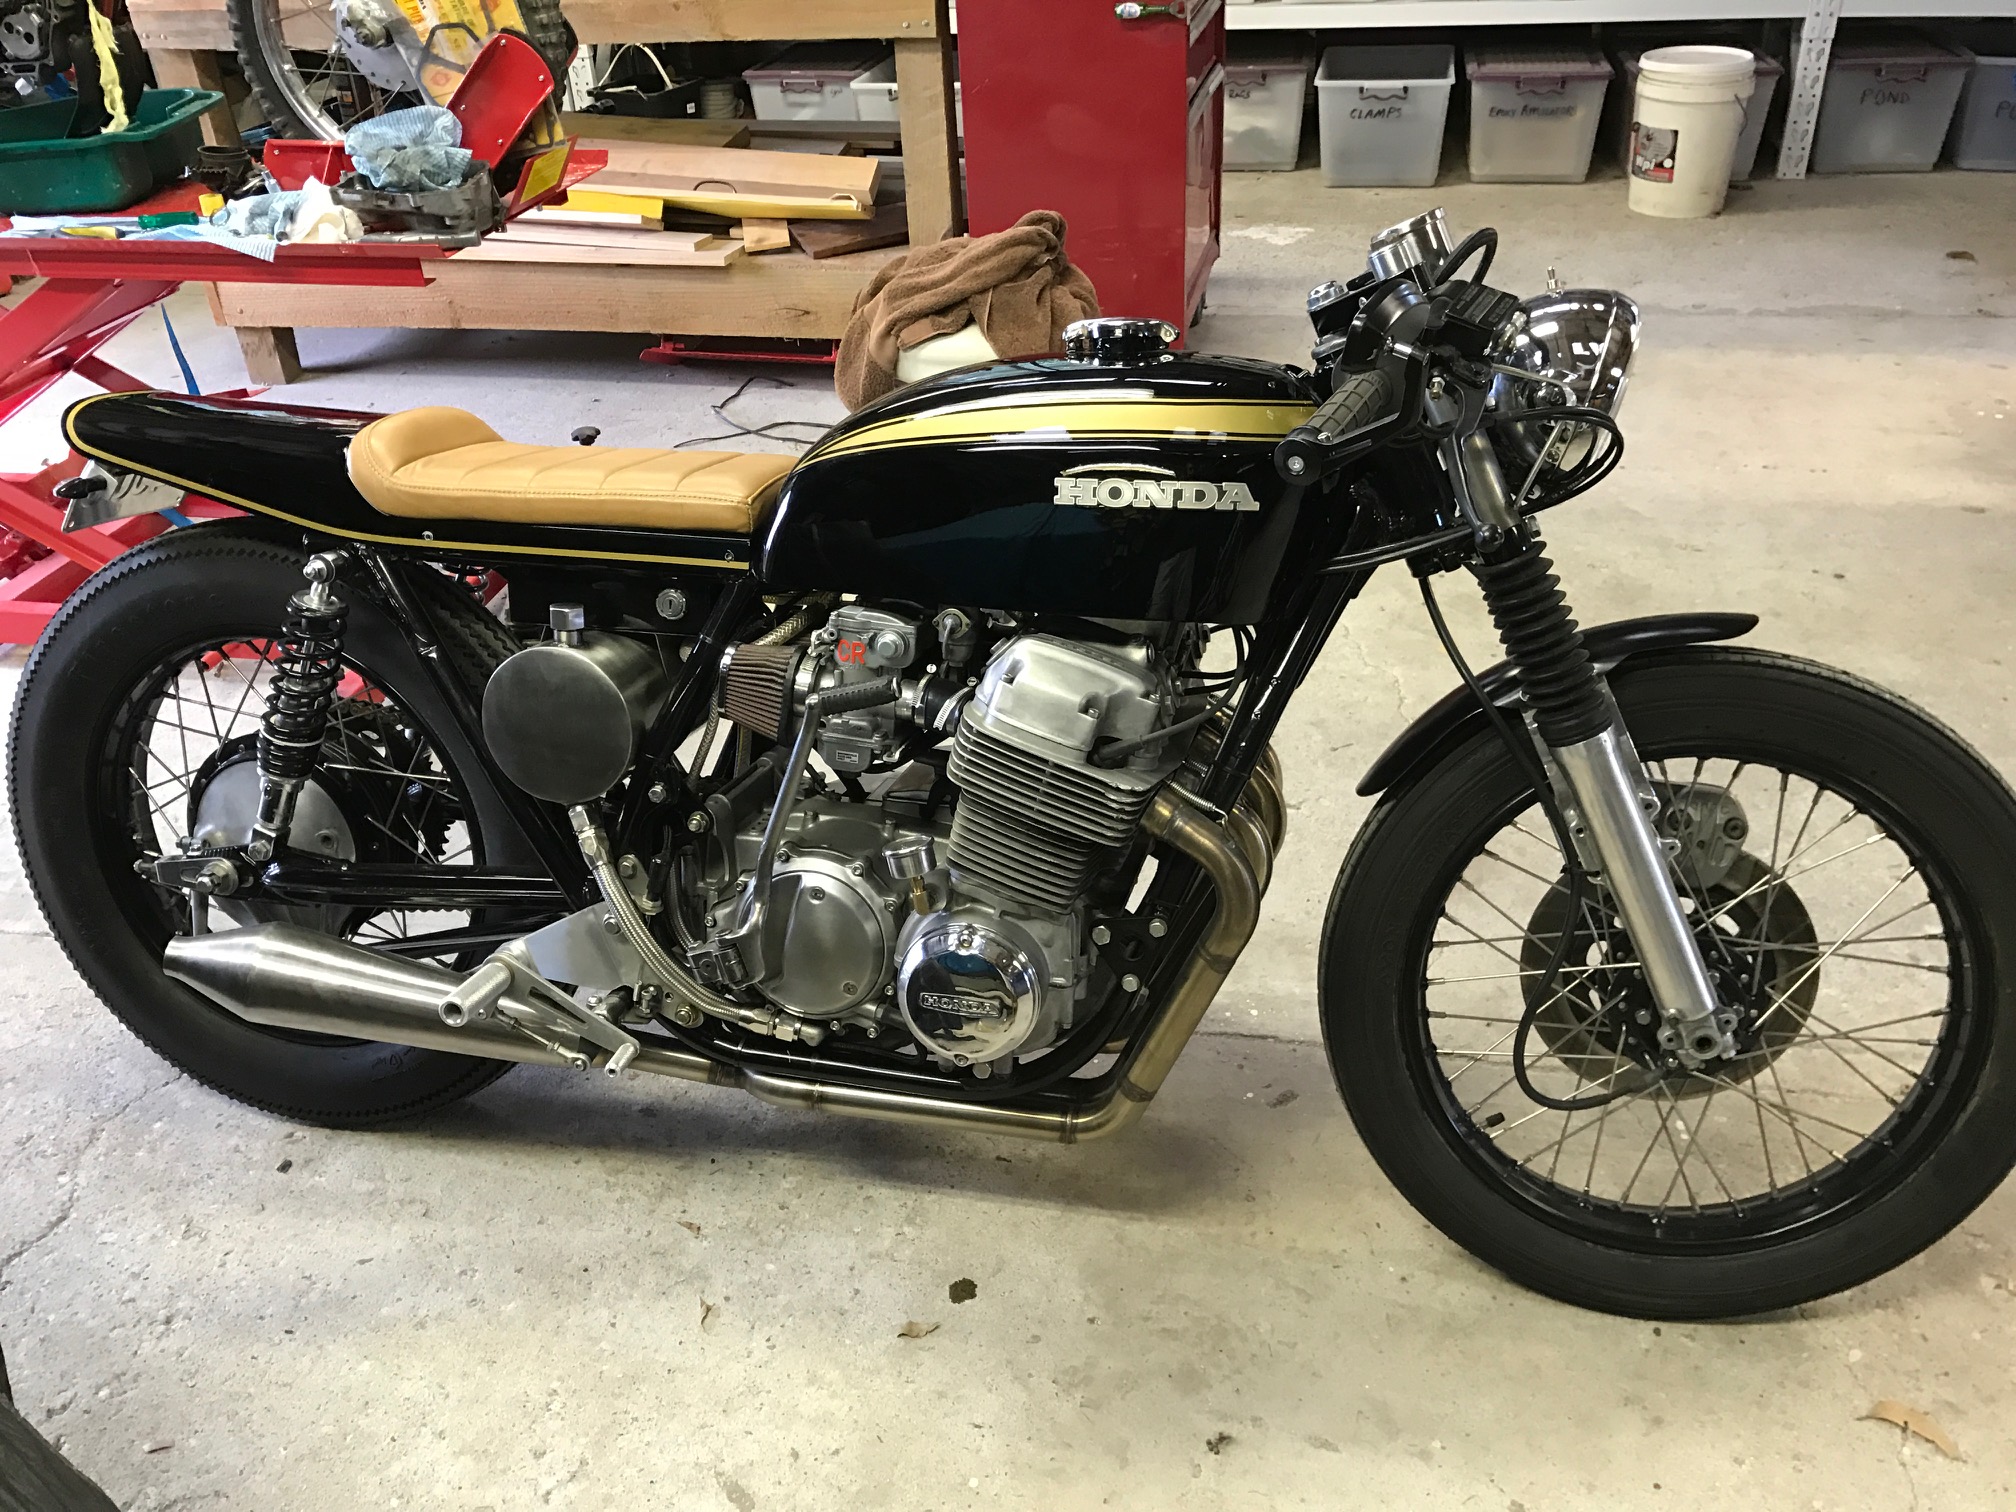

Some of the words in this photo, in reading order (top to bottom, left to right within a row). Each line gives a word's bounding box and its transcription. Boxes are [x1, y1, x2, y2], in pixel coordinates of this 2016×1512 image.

[1860, 88, 1910, 105] POND
[1350, 106, 1402, 119] CLAMPS
[1054, 477, 1260, 511] HONDA
[837, 639, 866, 664] CR
[923, 994, 998, 1014] HONDA
